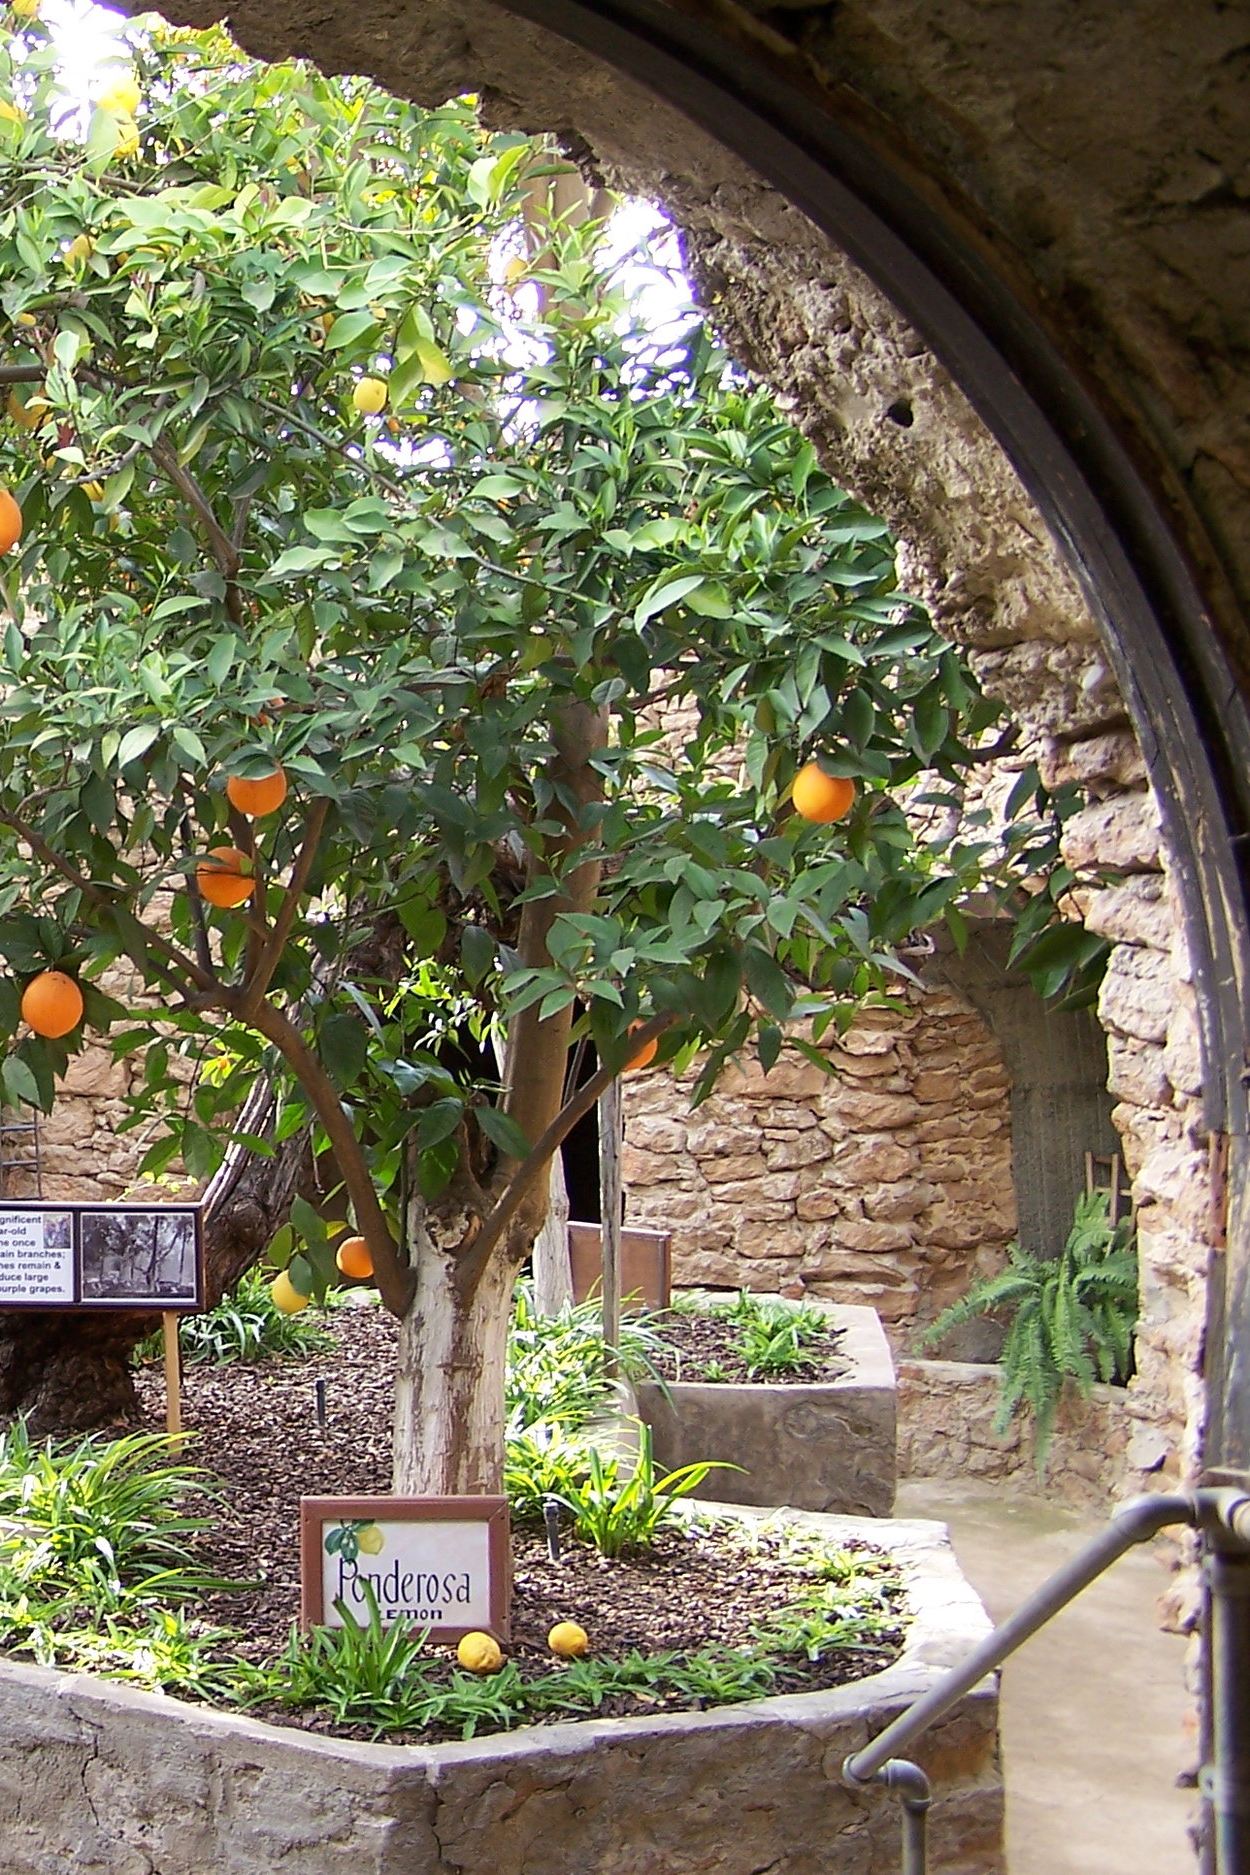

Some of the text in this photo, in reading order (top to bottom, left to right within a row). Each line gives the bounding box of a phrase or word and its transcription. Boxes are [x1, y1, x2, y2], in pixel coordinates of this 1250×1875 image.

[17, 1250, 65, 1259] branches;
[54, 1261, 61, 1269] &
[25, 1273, 49, 1283] large
[29, 1285, 65, 1294] grapes.
[338, 1558, 471, 1604] Ponderosa
